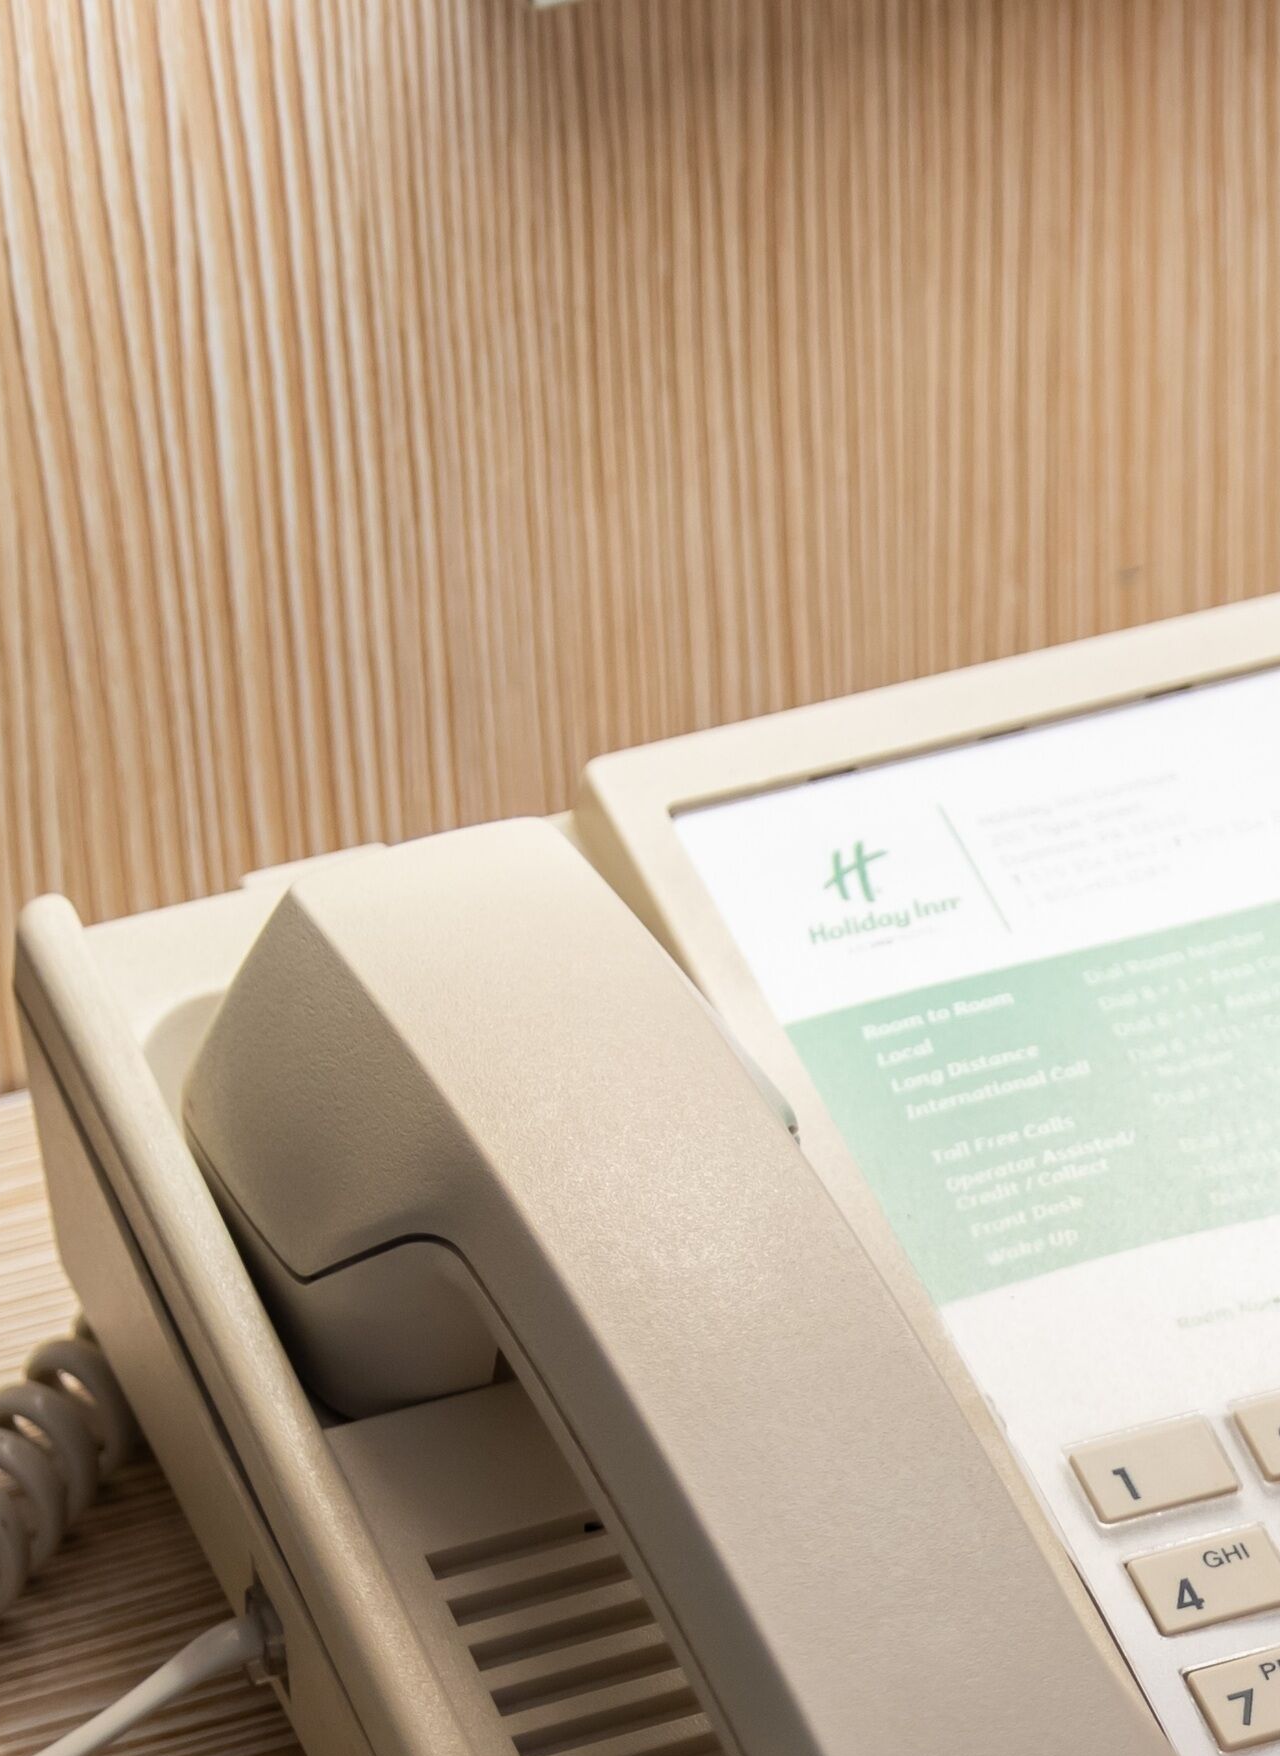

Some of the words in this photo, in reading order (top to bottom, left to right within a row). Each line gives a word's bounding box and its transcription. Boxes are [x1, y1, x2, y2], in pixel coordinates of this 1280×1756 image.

[808, 911, 911, 945] Holiday
[862, 1010, 924, 1041] Room
[927, 1006, 951, 1025] to
[952, 992, 1016, 1019] Room
[875, 1038, 935, 1068] Local
[889, 1065, 945, 1095] Long
[946, 1043, 1040, 1079] Distance
[906, 1069, 1048, 1121] International
[1050, 1059, 1093, 1085] Call
[931, 1140, 971, 1166] Toll
[974, 1127, 1020, 1153] Free
[1023, 1114, 1076, 1139] Calls
[945, 1156, 1038, 1194] Operator
[956, 1179, 1020, 1212] Credit
[1038, 1157, 1111, 1187] Collect
[970, 1212, 1027, 1240] Front
[1031, 1193, 1084, 1220] Desk
[986, 1237, 1046, 1267] Wake
[1048, 1226, 1080, 1248] Up
[1111, 1465, 1143, 1502] 1
[1201, 1541, 1252, 1570] GHI
[1175, 1577, 1206, 1613] 4
[1226, 1687, 1255, 1727] 7
